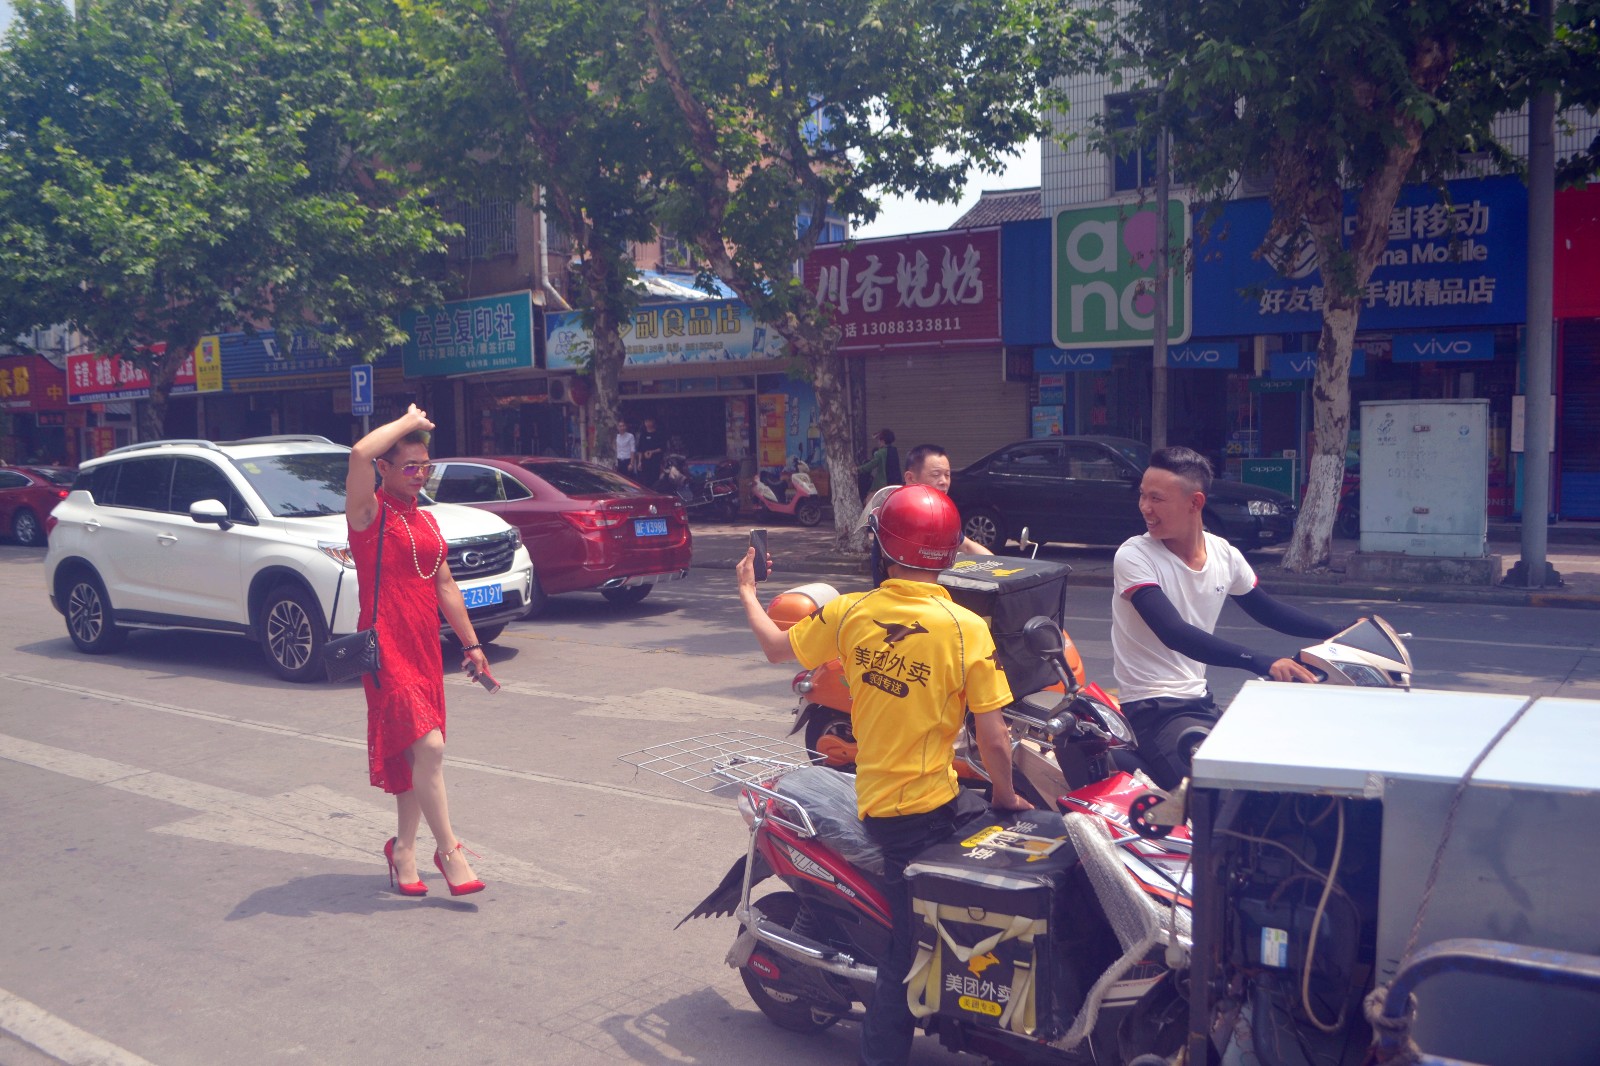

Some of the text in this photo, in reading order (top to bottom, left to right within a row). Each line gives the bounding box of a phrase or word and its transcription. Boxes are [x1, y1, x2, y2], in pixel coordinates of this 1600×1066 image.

[815, 243, 984, 315] 川香烧烤
[1258, 275, 1496, 316] 好友智手机精品店
[414, 302, 517, 348] 云兰复印社
[861, 316, 961, 336] 13088333811
[1049, 351, 1095, 365] vivo
[1171, 346, 1220, 362] vivo
[1413, 337, 1472, 354] vivo
[353, 371, 367, 402] P
[853, 645, 932, 688] 美团外卖
[945, 972, 1012, 1003] 美团外卖
